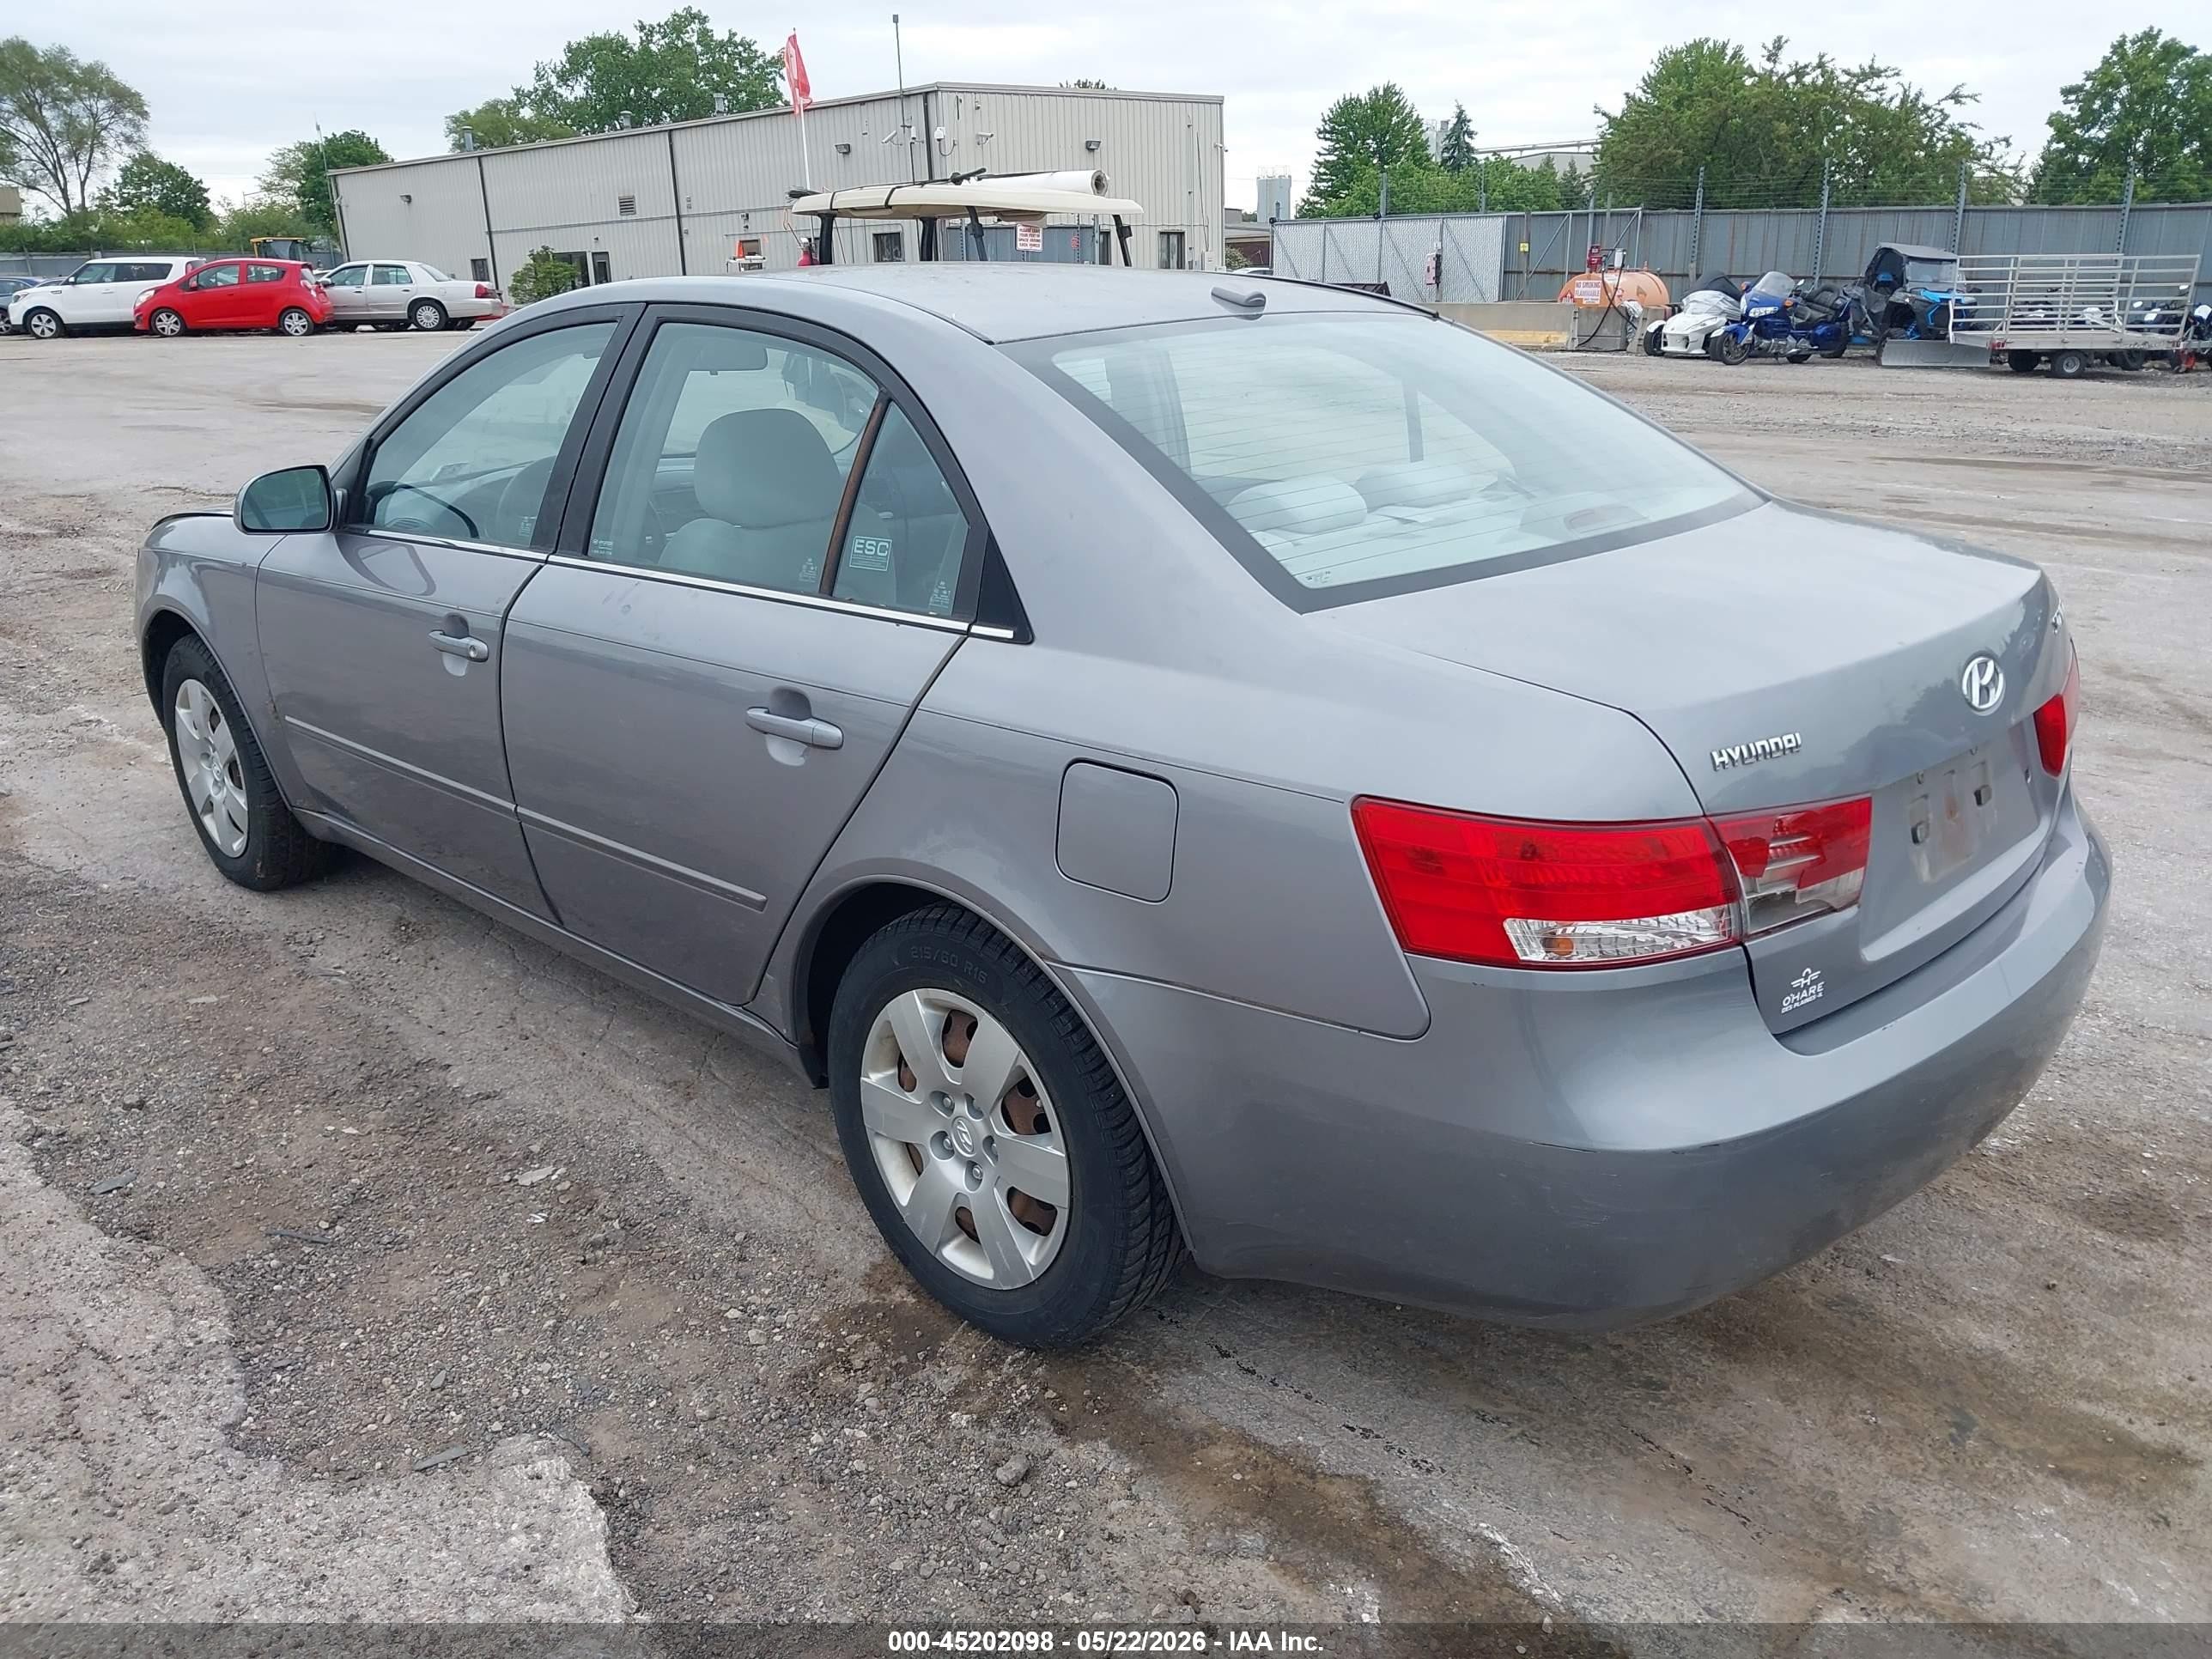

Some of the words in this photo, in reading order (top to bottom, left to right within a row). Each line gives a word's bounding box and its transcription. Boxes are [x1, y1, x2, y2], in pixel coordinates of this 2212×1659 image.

[854, 538, 889, 556] ESC
[1711, 732, 1802, 769] HYUNDAI
[910, 945, 958, 968] 215/60
[963, 960, 988, 984] R16
[1782, 981, 1825, 1006] O'HARE
